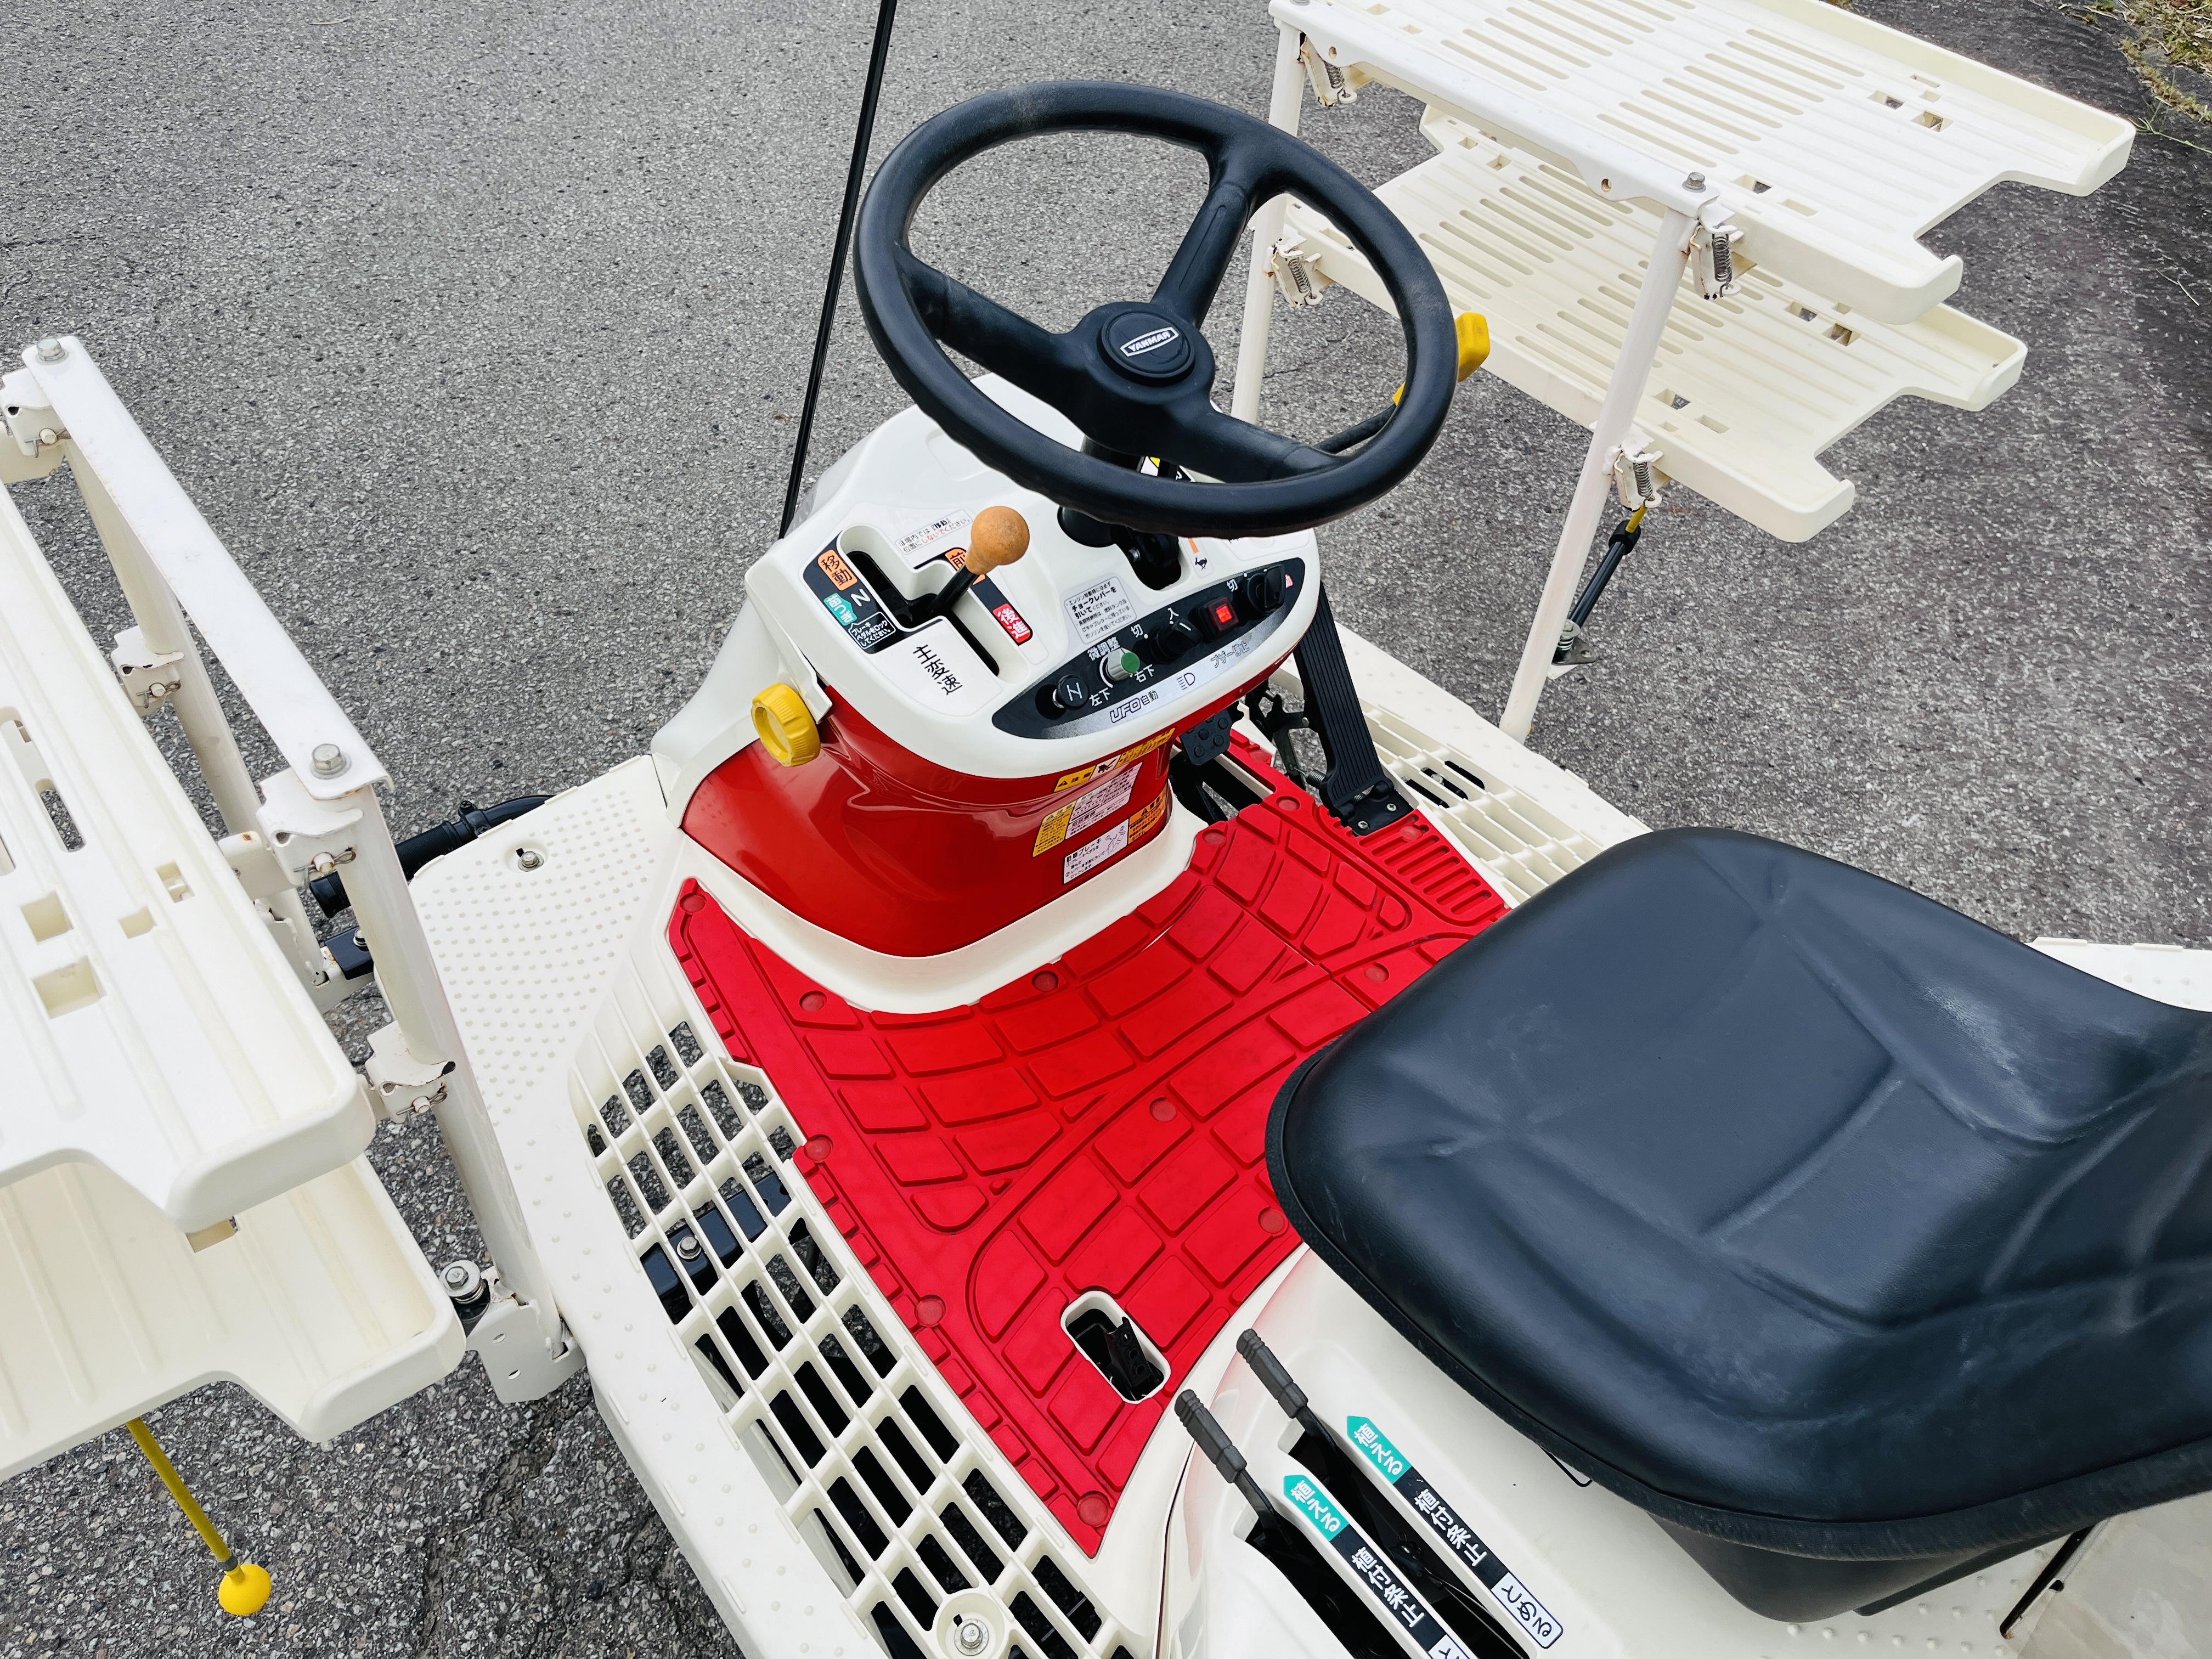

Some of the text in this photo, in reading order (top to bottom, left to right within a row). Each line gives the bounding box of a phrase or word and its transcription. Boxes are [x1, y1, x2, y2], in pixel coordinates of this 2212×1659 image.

[1127, 331, 1171, 352] YANMAR
[903, 518, 970, 553] 位置にしないでください。
[821, 555, 853, 586] 移動
[850, 589, 871, 607] N
[1227, 579, 1238, 592] 切
[1071, 586, 1117, 613] チョークレバーを
[1074, 601, 1109, 619] 引いてください。
[997, 608, 1030, 640] 後進
[1167, 607, 1180, 620] 入
[851, 622, 871, 636] ブレーキ
[860, 629, 891, 646] してください。
[1131, 624, 1143, 638] 切
[1087, 636, 1121, 661] 微調整
[1210, 640, 1250, 668] ブザー停止
[912, 645, 963, 696] 主変速
[1135, 664, 1155, 683] 右下
[1089, 687, 1110, 707] 左下
[1353, 1423, 1403, 1475] 植える
[1290, 1480, 1341, 1532] 植える
[1414, 1488, 1487, 1567] 植付条止
[1352, 1547, 1425, 1628] 植付条止
[1501, 1585, 1552, 1637] とめる
